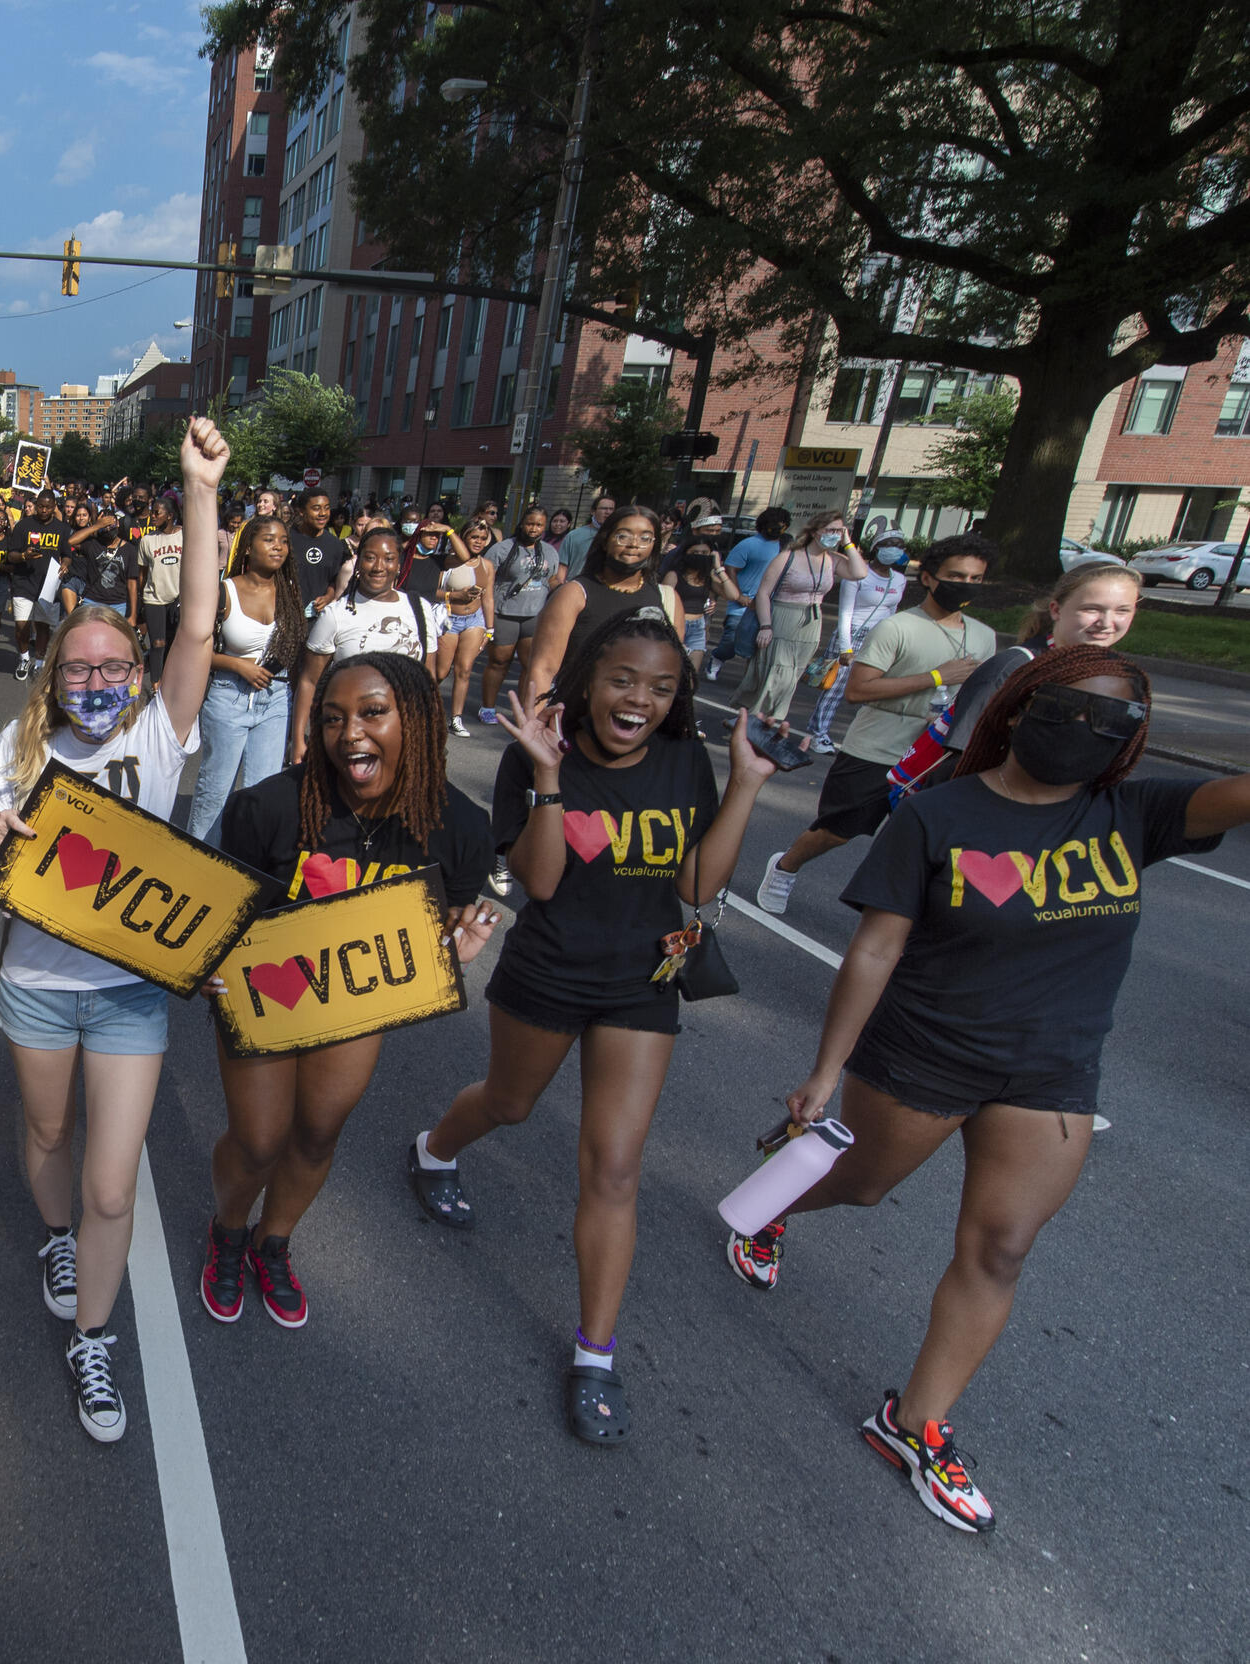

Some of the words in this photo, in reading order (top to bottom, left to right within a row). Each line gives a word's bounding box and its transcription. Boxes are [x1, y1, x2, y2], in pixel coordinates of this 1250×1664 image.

[812, 450, 846, 465] VCU
[39, 532, 60, 548] VCU
[67, 794, 95, 815] VCU
[287, 850, 311, 901] I
[950, 848, 965, 907] I
[1008, 830, 1139, 908] VCU
[35, 825, 72, 878] I
[91, 851, 212, 950] VCU
[1033, 900, 1140, 922] vcualumni.org
[241, 965, 266, 1018] I
[293, 928, 418, 1005] VCU
